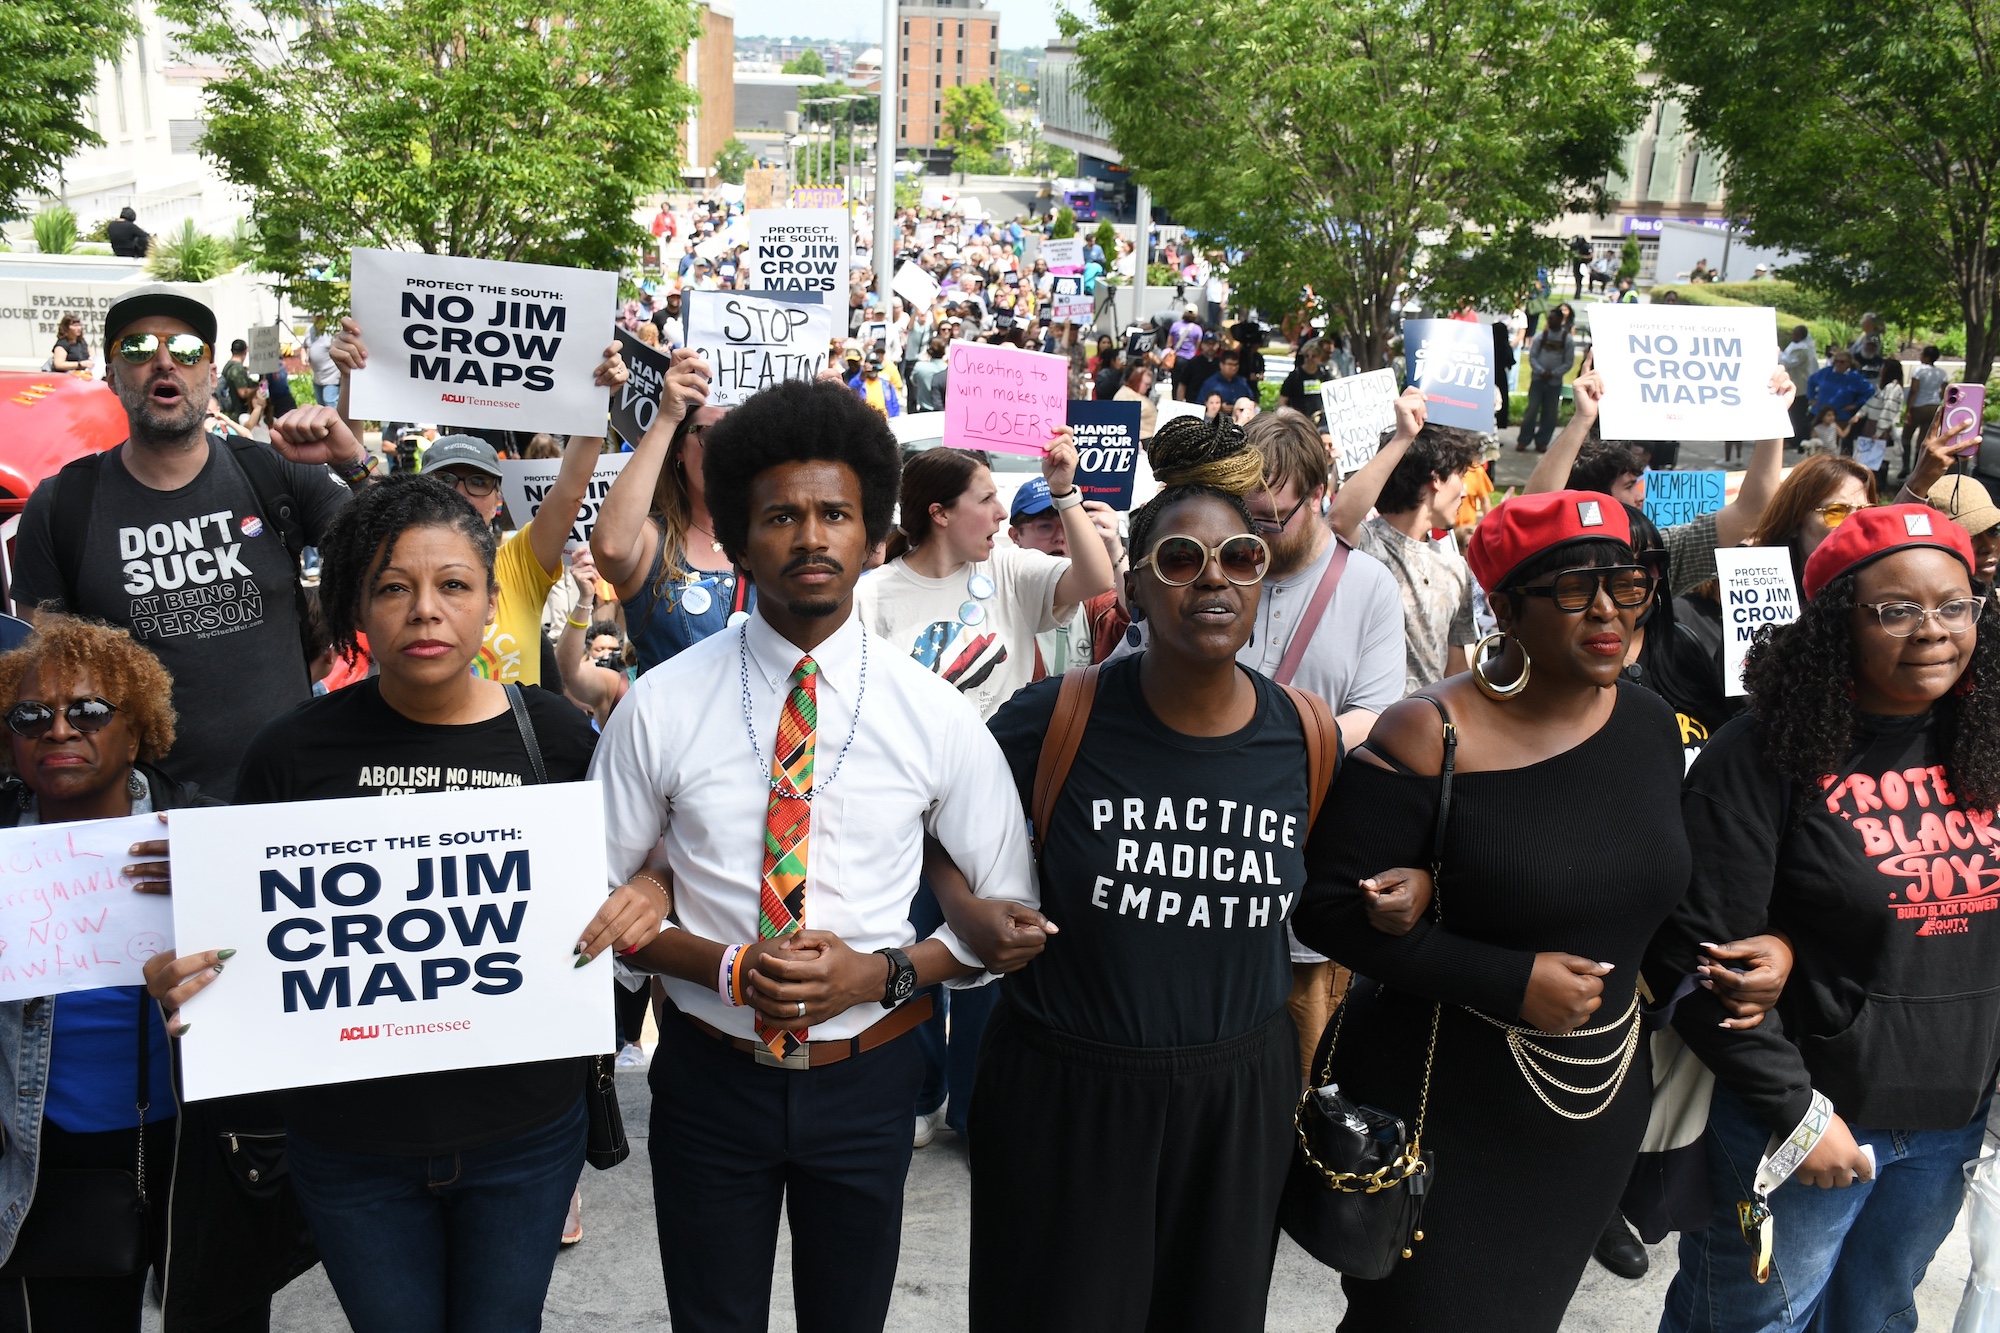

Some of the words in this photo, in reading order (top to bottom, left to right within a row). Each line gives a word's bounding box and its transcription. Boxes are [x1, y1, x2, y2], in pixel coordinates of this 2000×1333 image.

[769, 226, 829, 234] PROTECT
[1630, 218, 1652, 231] Bus
[760, 235, 785, 243] THE
[790, 235, 838, 243] SOUTH:
[758, 245, 794, 259] NO
[801, 245, 839, 259] JIM
[760, 261, 838, 275] CROW
[406, 278, 474, 292] PROTECT
[478, 285, 507, 295] THE
[510, 288, 563, 300] SOUTH:
[764, 277, 836, 291] MAPS
[32, 295, 95, 308] SPEAKER
[401, 291, 474, 323] NO
[488, 300, 567, 332] JIM
[42, 308, 60, 321] OF
[724, 300, 809, 342] STOP
[1629, 323, 1675, 331] PROTECT
[403, 323, 562, 362] CROW
[1628, 334, 1678, 356] NO
[1689, 337, 1742, 358] JIM
[410, 353, 555, 392] MAPS
[953, 348, 1024, 386] Cheating
[1030, 364, 1048, 381] to
[1414, 359, 1490, 390] VOTE
[1633, 358, 1741, 382] CROW
[441, 393, 466, 404] ACLU
[467, 395, 520, 409] Tennessee
[957, 381, 982, 398] win
[993, 388, 1037, 405] makes
[1041, 394, 1063, 411] you
[1326, 380, 1356, 407] NOT
[1640, 383, 1741, 406] MAPS
[965, 406, 1057, 440] LOSERS
[1073, 424, 1127, 436] HANDS
[1101, 436, 1132, 447] OUR
[1646, 473, 1720, 500] MEMPHIS
[119, 509, 234, 561] DON'T
[122, 542, 253, 596] SUCK
[1734, 567, 1779, 577] PROTECT
[1728, 578, 1750, 586] THE
[1752, 577, 1788, 586] SOUTH:
[130, 595, 160, 618] AT
[163, 582, 237, 611] BEING
[241, 578, 261, 598] A
[1729, 589, 1759, 605] NO
[1765, 587, 1792, 603] JIM
[132, 596, 264, 640] PERSON
[1732, 605, 1794, 624] CROW
[197, 619, 264, 640] MyCluckHut.com
[358, 766, 441, 787] ABOLISH
[446, 767, 468, 785] NO
[471, 769, 523, 787] HUMAN
[1092, 796, 1297, 849] PRACTICE
[1852, 808, 2000, 857] BLACK
[265, 838, 378, 859] PROTECT
[385, 834, 431, 850] THE
[438, 828, 523, 847] SOUTH:
[1116, 838, 1282, 886] RADICAL
[259, 862, 382, 913] NO
[406, 849, 531, 901] JIM
[1902, 853, 1985, 903] JOY
[1091, 874, 1294, 929] EMPATHY
[1897, 906, 1927, 919] BUILD
[1927, 903, 1959, 917] BLACK
[1960, 897, 1998, 914] POWER
[266, 900, 529, 962] CROW
[1928, 917, 1969, 931] EQUITY
[281, 951, 524, 1013] MAPS
[339, 1025, 380, 1042] ACLU
[382, 1018, 472, 1038] Tennessee
